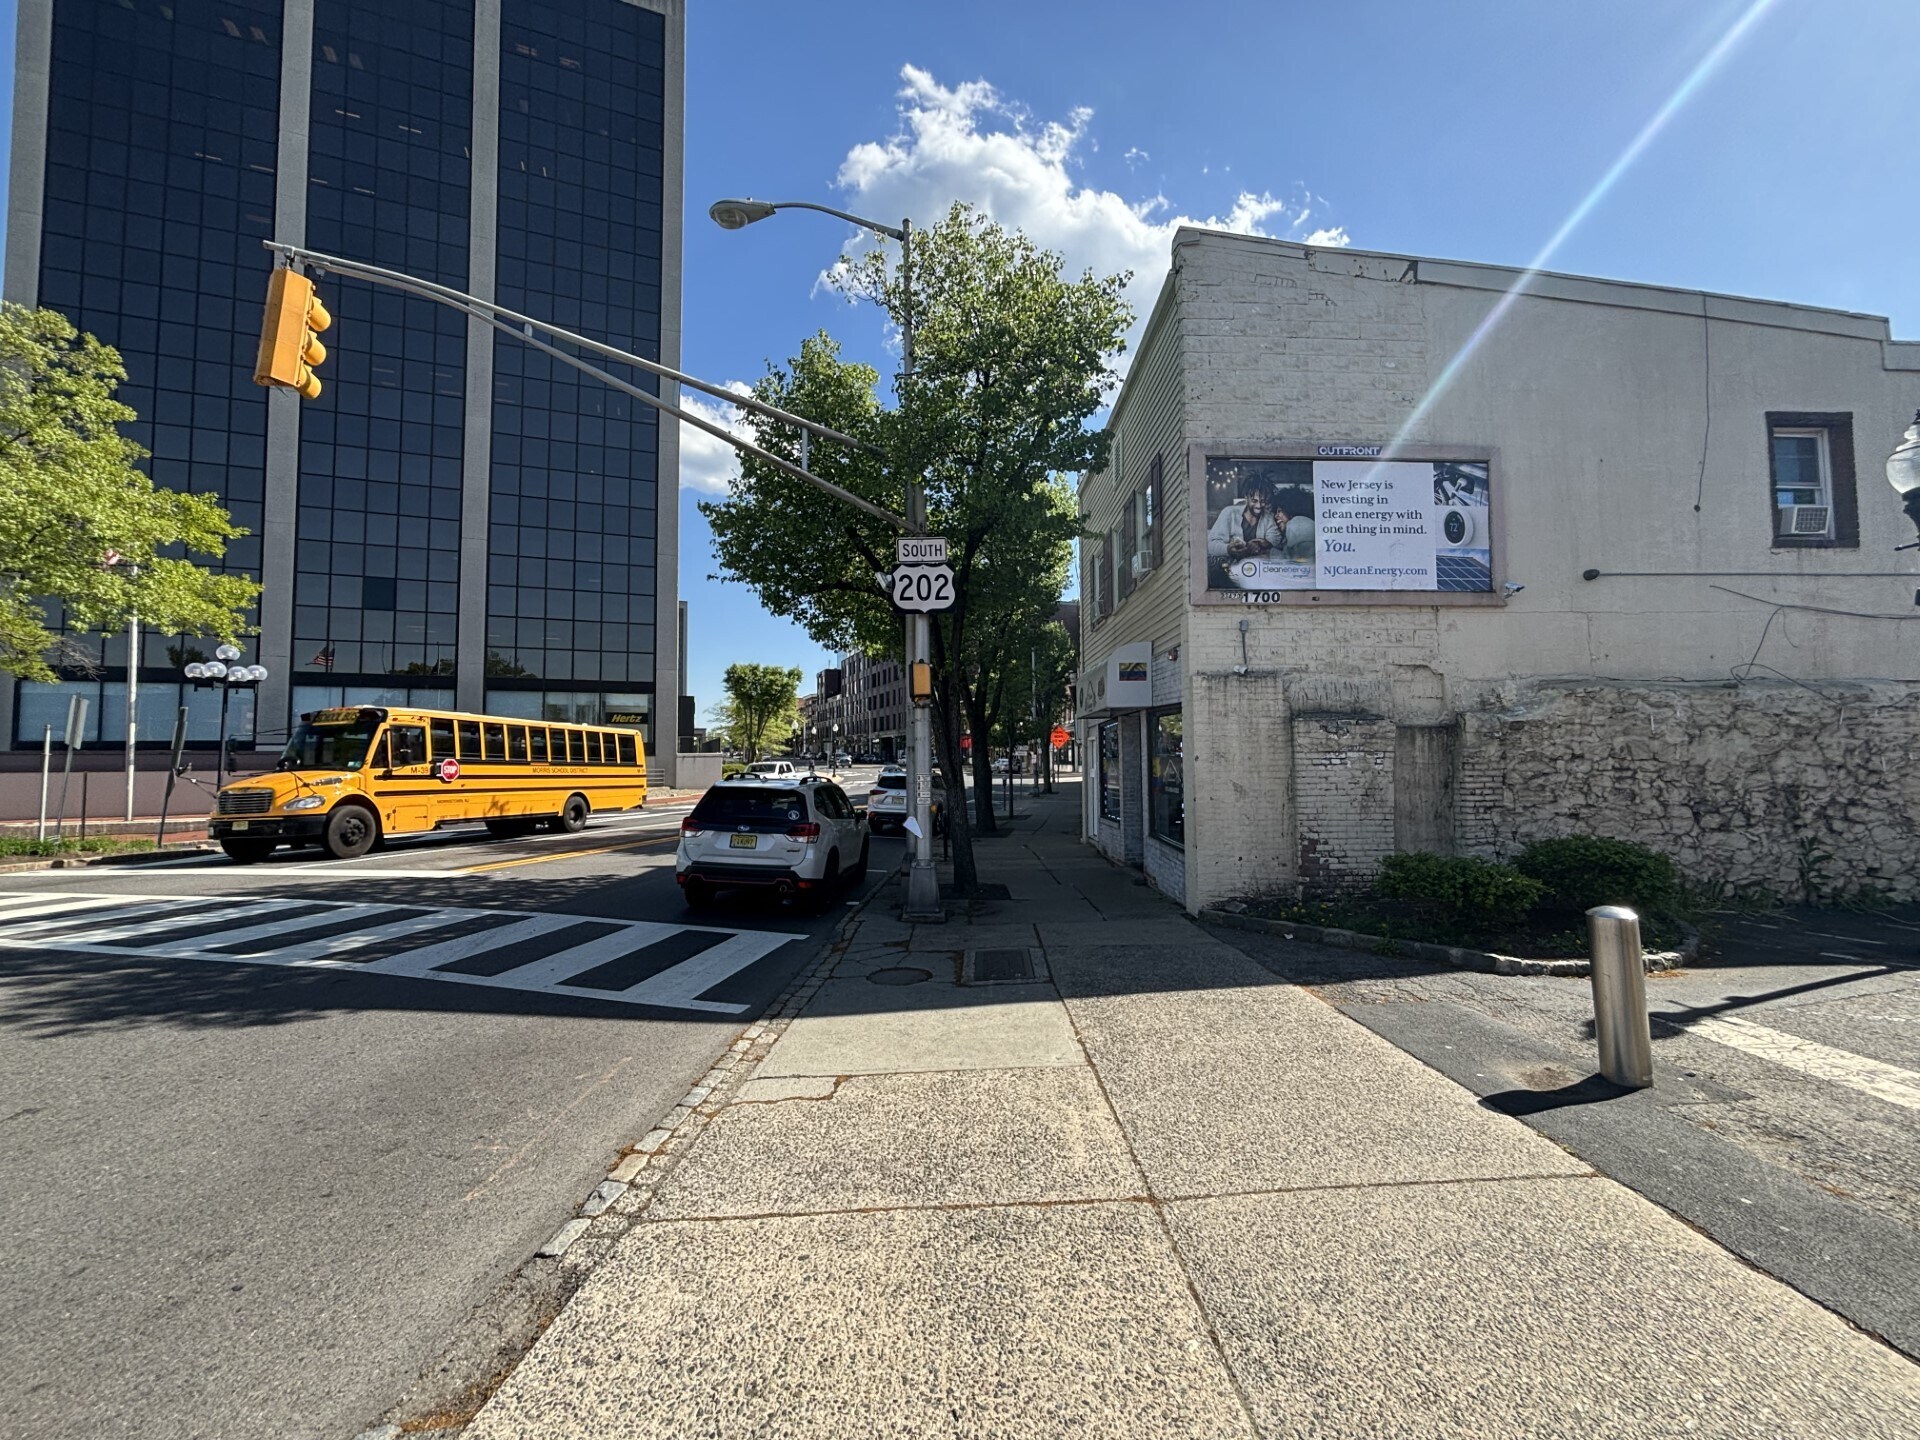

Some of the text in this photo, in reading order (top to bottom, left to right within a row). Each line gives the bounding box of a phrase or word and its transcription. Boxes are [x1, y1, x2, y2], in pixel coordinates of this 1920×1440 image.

[1319, 447, 1380, 455] OUTFRONT
[1321, 480, 1394, 491] New Jersey is
[1322, 494, 1388, 506] investing in
[1322, 509, 1423, 521] clean energy with
[1322, 524, 1427, 536] one thing in mind.
[902, 543, 943, 558] SOUTH
[1323, 539, 1356, 553] You.
[1323, 565, 1428, 577] NJCleanEnergy.com
[898, 573, 950, 602] 202
[1243, 592, 1281, 603] 1700
[611, 714, 642, 723] Hertz
[443, 765, 457, 774] STOP
